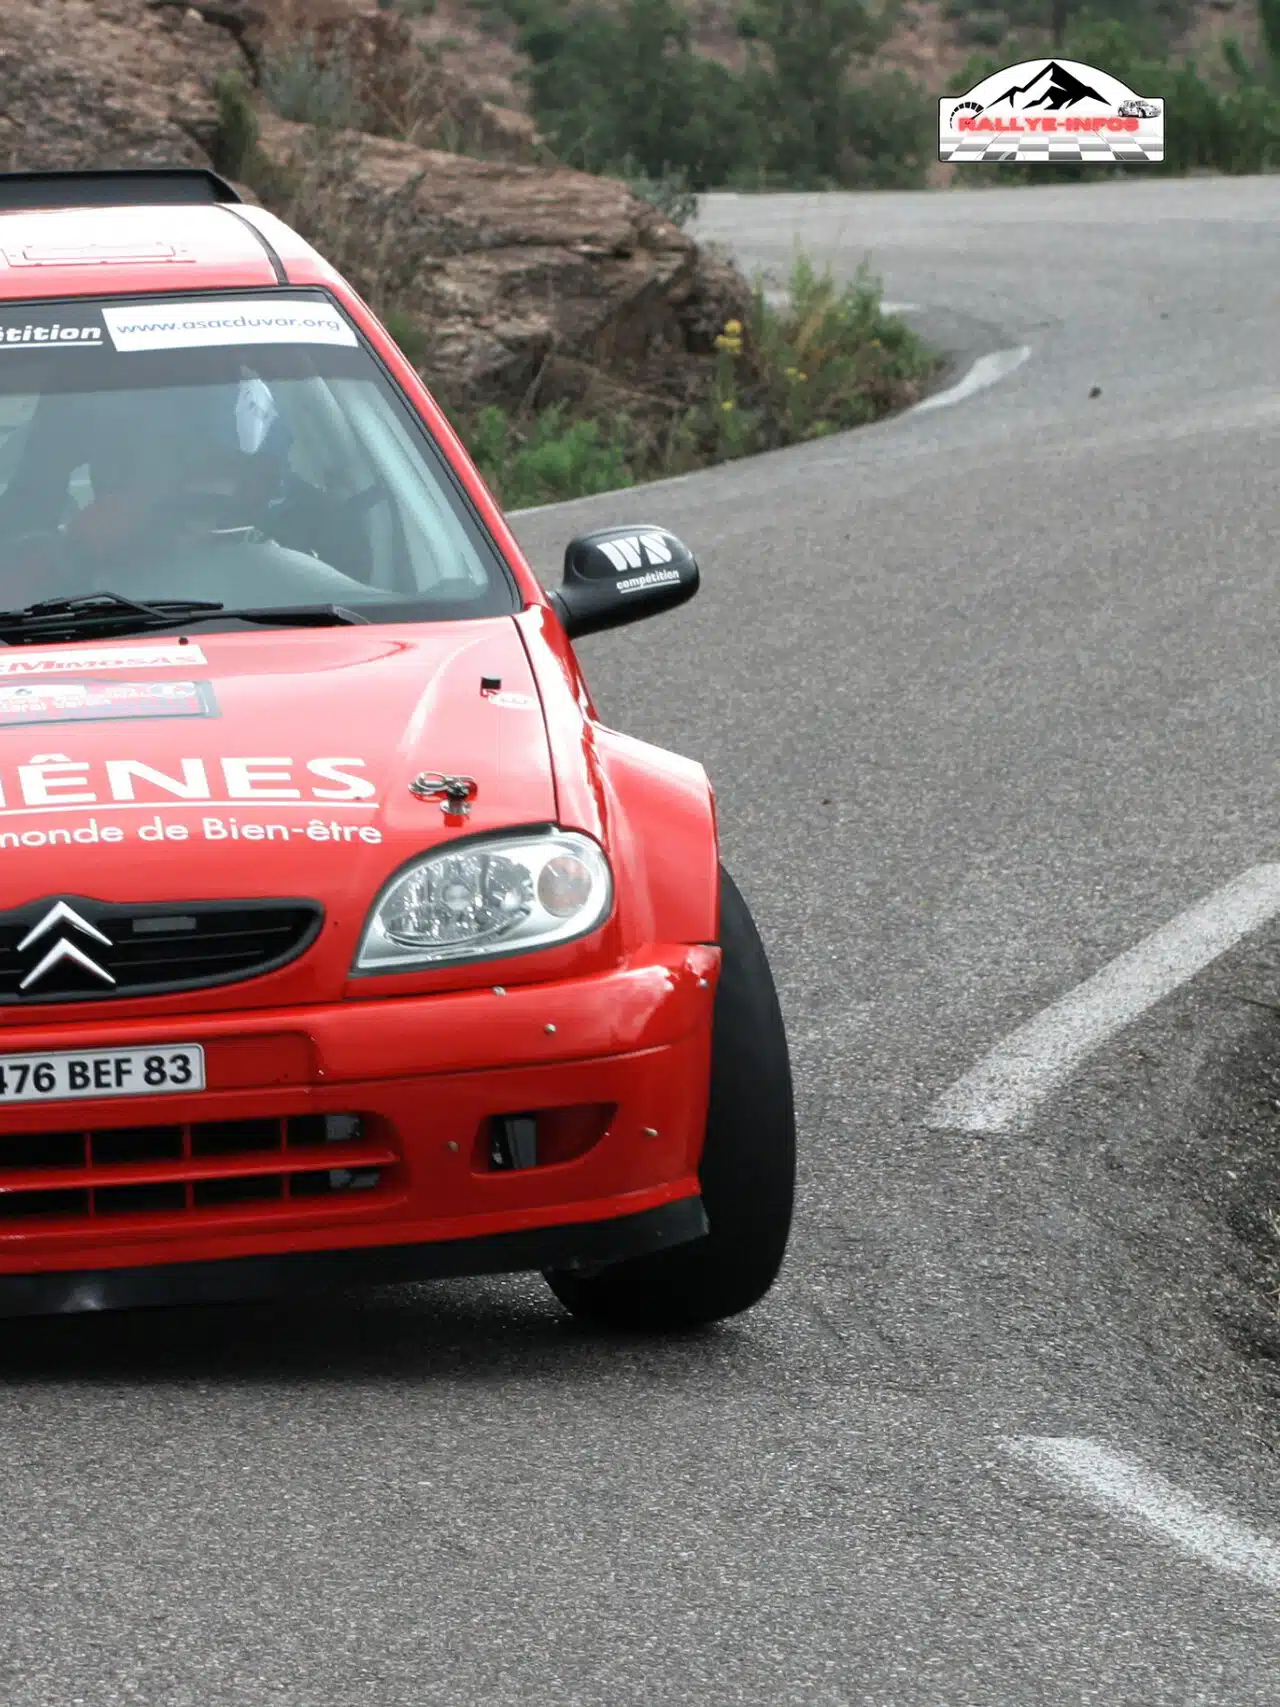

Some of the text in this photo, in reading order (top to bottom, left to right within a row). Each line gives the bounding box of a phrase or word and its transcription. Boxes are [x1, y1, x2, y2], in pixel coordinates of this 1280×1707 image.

[116, 316, 341, 332] www.asacduvar.org
[616, 569, 680, 590] compétition
[137, 816, 189, 841] de
[202, 817, 383, 844] Bien-être
[68, 1058, 133, 1090] BEF
[143, 1054, 193, 1086] 83
